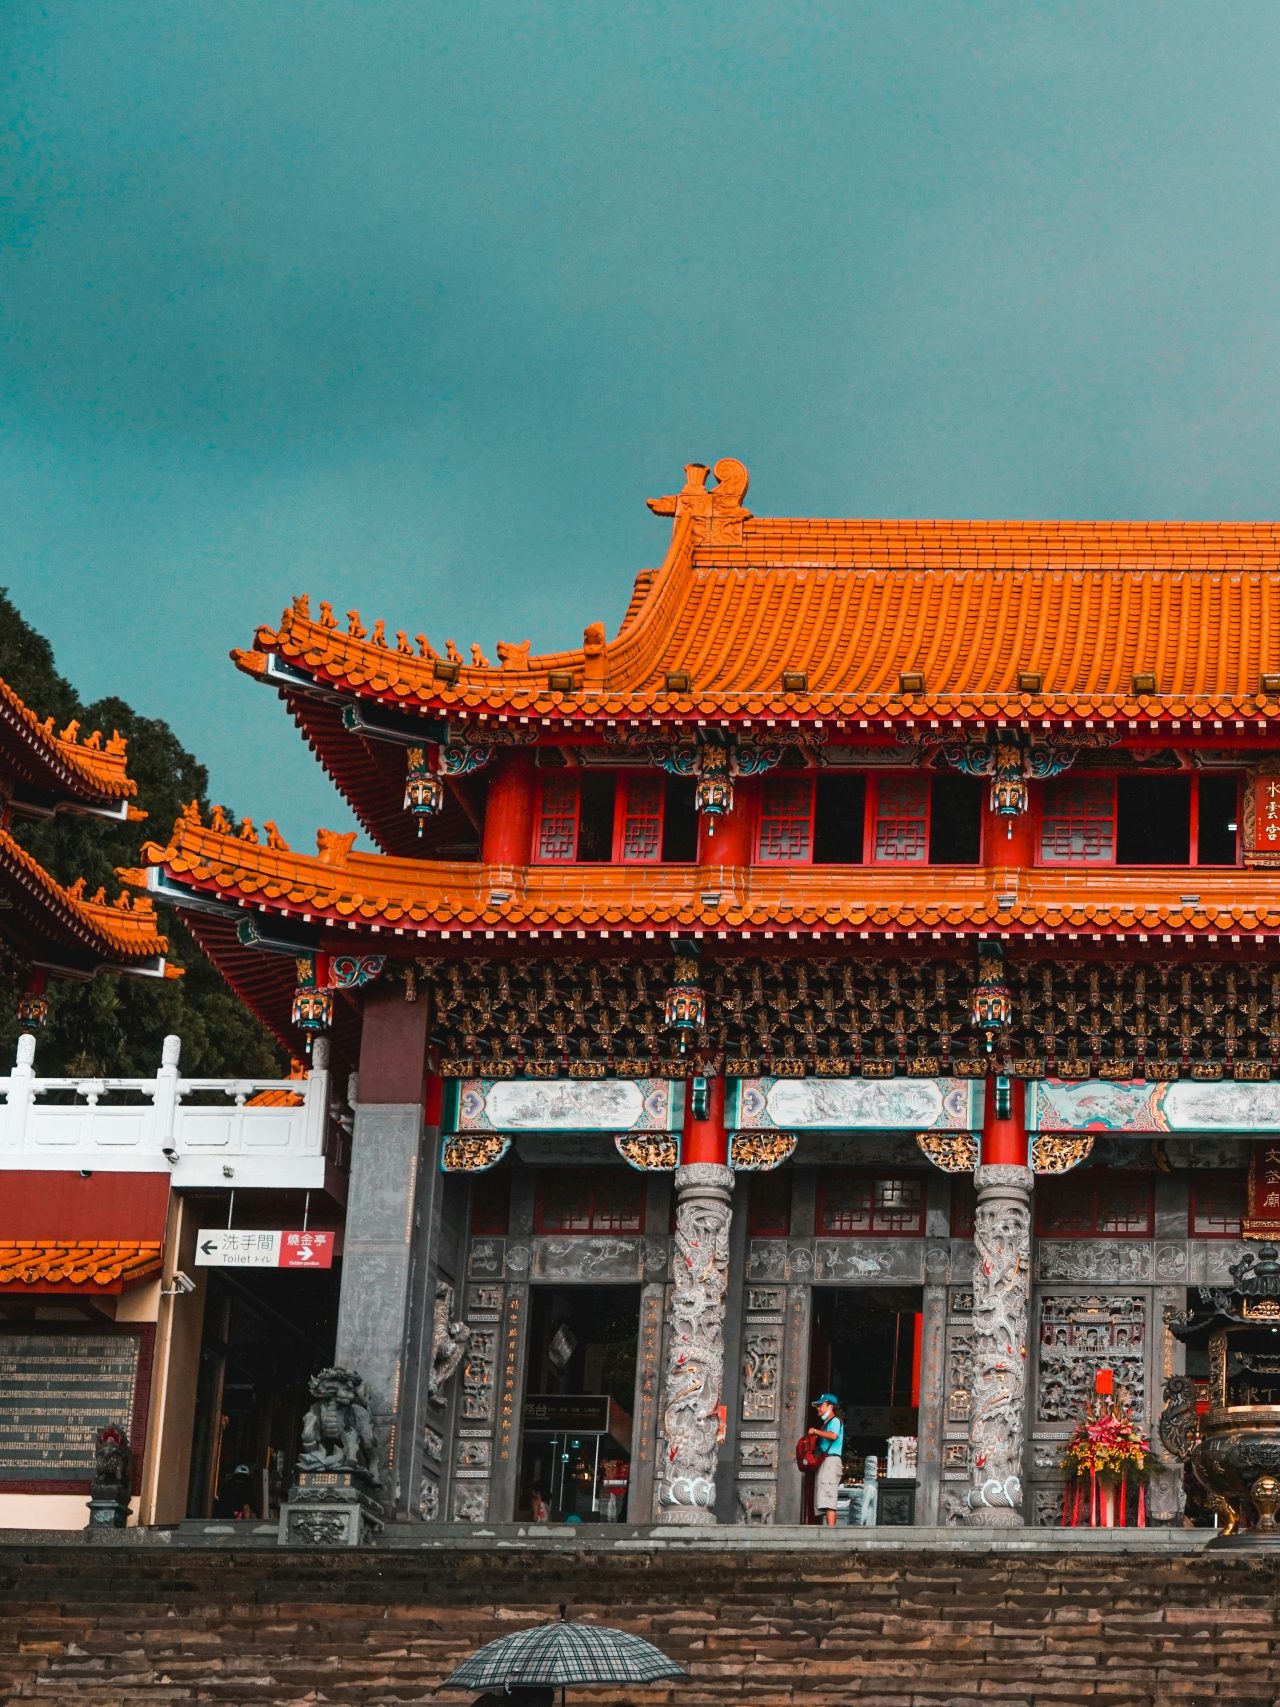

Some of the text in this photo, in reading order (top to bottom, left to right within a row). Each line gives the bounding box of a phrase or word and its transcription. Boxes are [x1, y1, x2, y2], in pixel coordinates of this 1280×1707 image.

[222, 1233, 274, 1251] 洗手間
[287, 1233, 326, 1247] 燒金亭
[222, 1254, 272, 1264] Toilet トイレ
